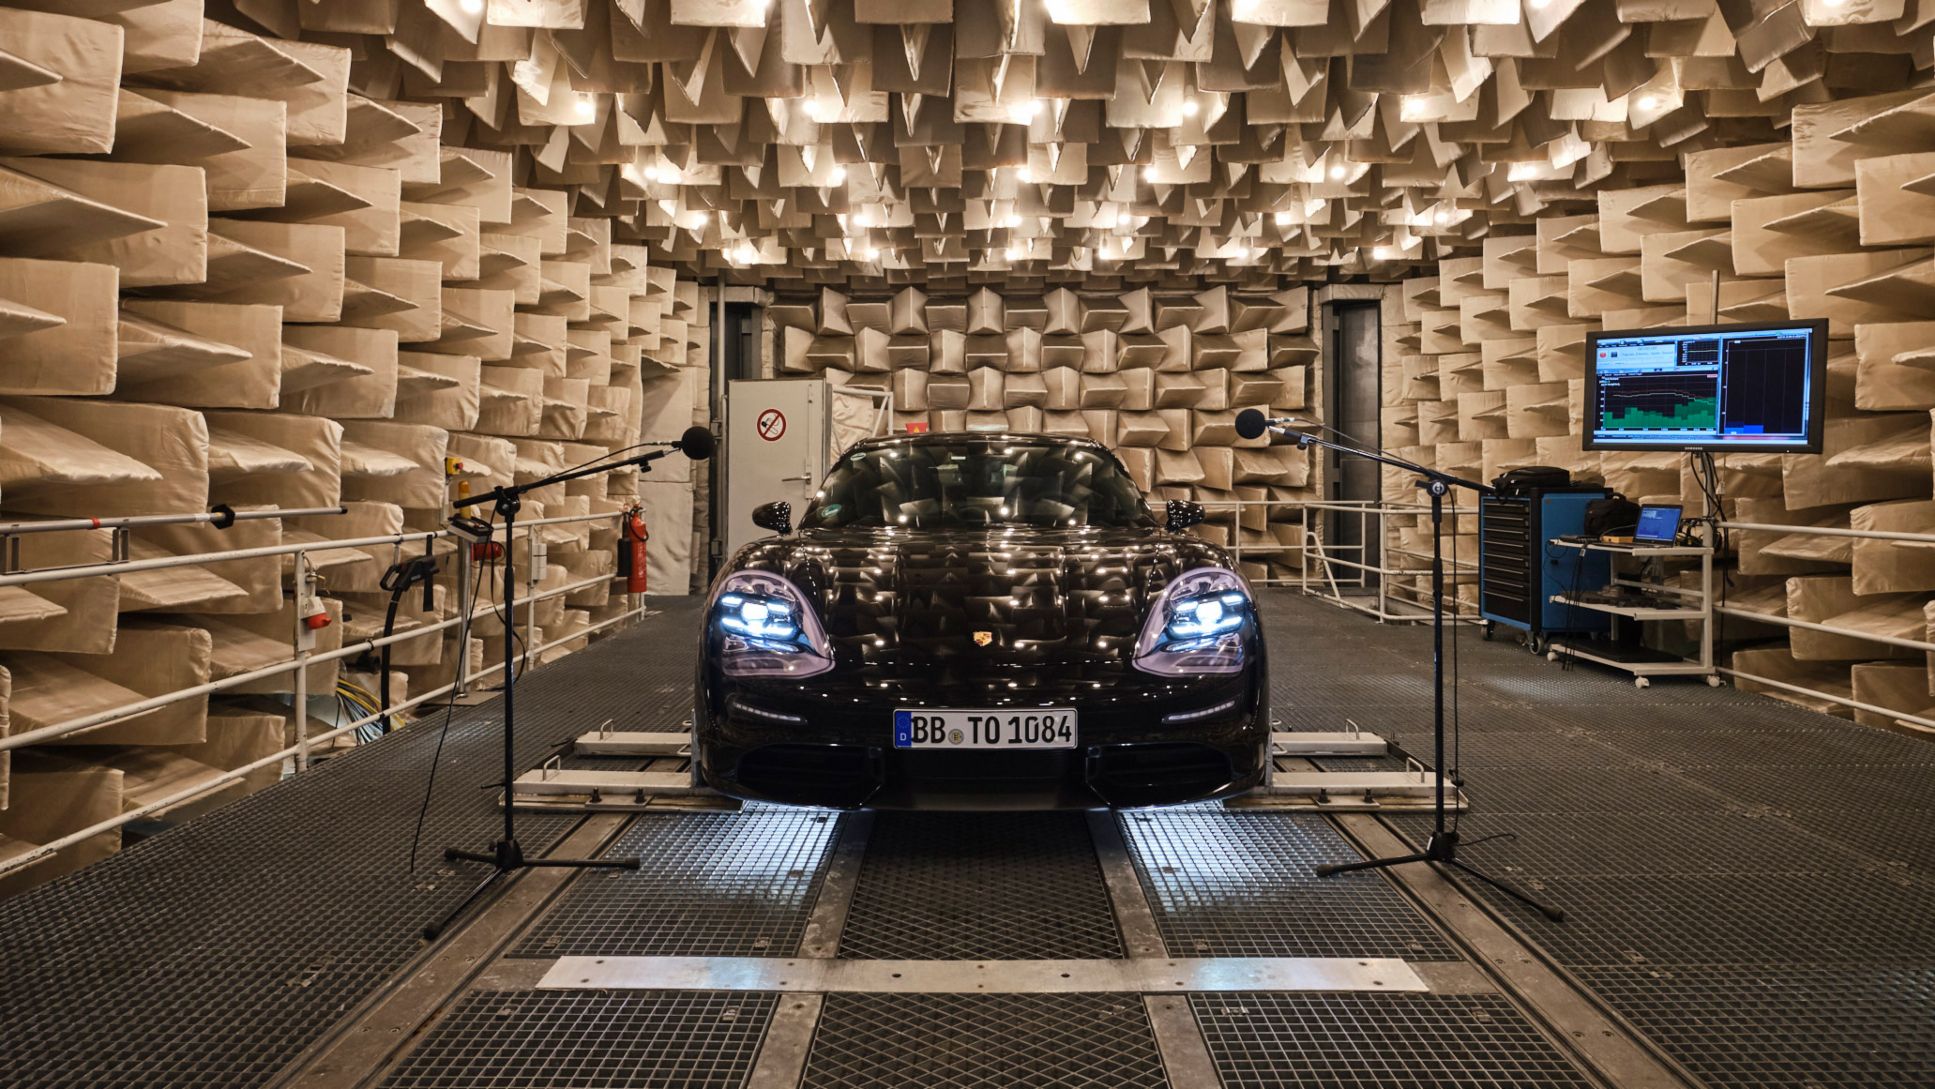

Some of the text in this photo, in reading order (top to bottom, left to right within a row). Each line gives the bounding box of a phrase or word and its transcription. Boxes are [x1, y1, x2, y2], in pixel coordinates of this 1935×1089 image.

[900, 715, 1072, 744] D BB TO 1084
